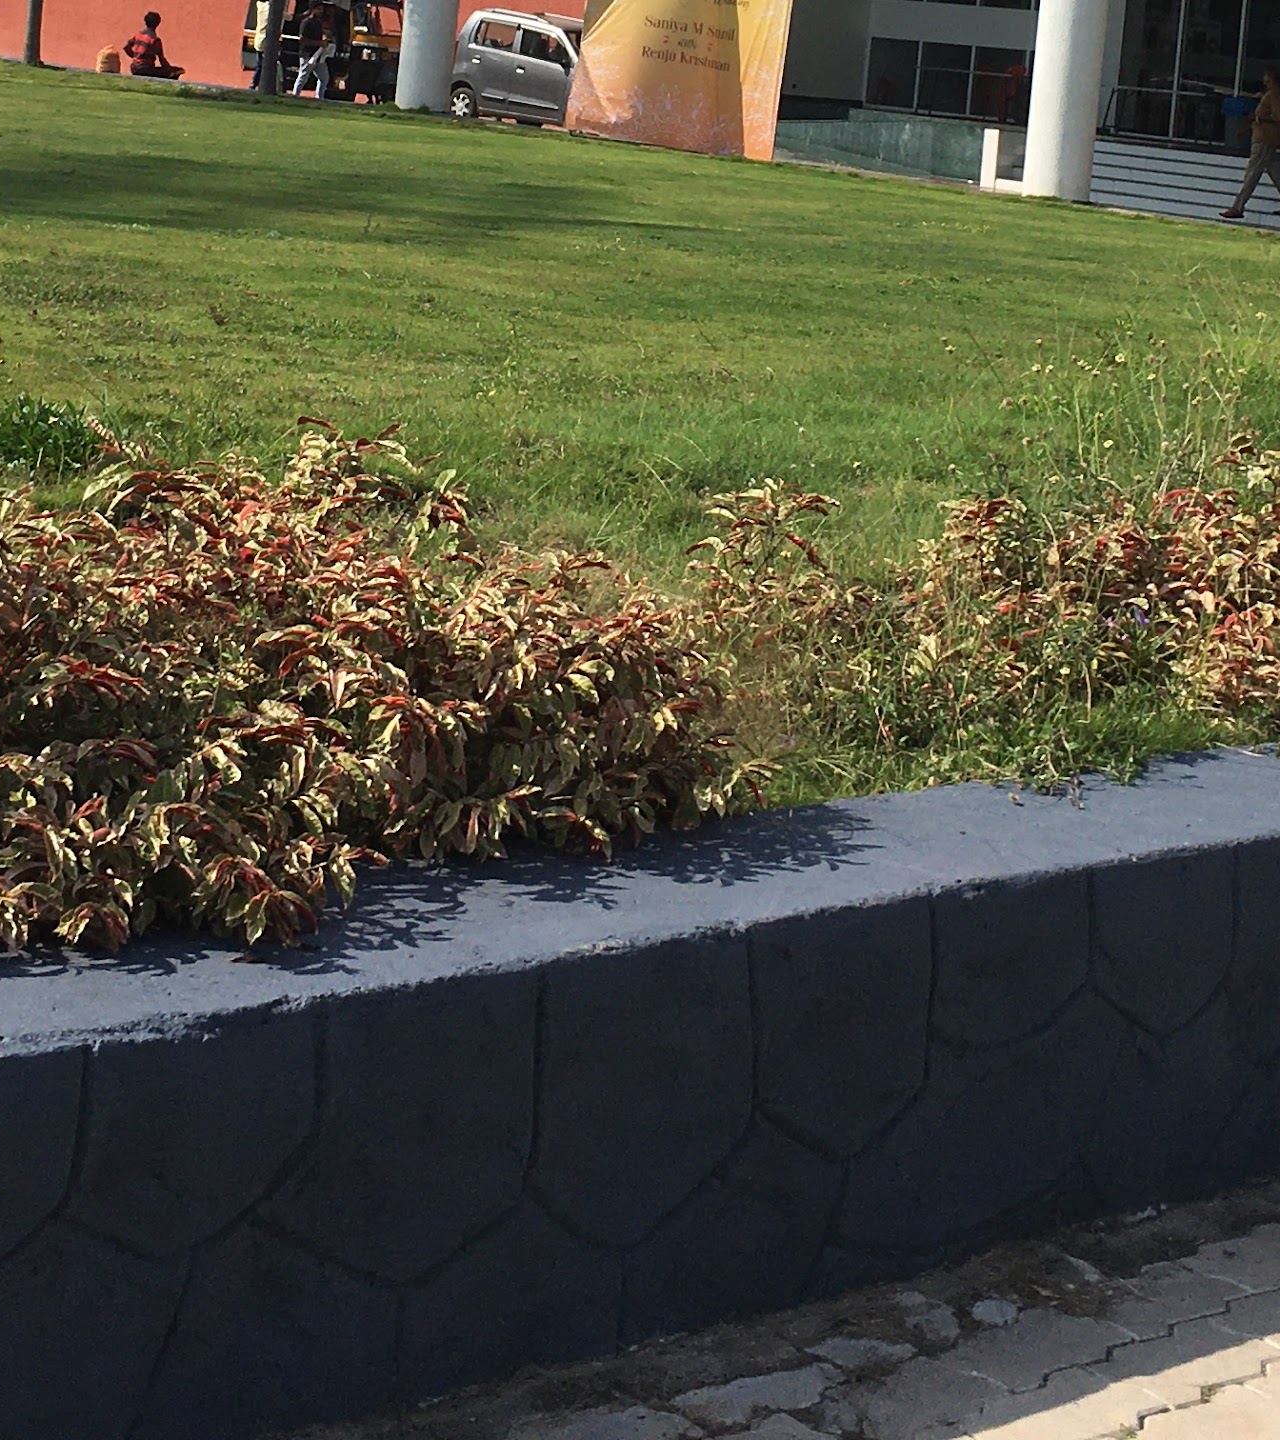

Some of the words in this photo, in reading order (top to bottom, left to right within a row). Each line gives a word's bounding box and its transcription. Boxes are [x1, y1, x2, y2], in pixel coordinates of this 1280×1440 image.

[644, 16, 688, 32] Saniya
[693, 22, 704, 35] M
[641, 46, 677, 63] Renju
